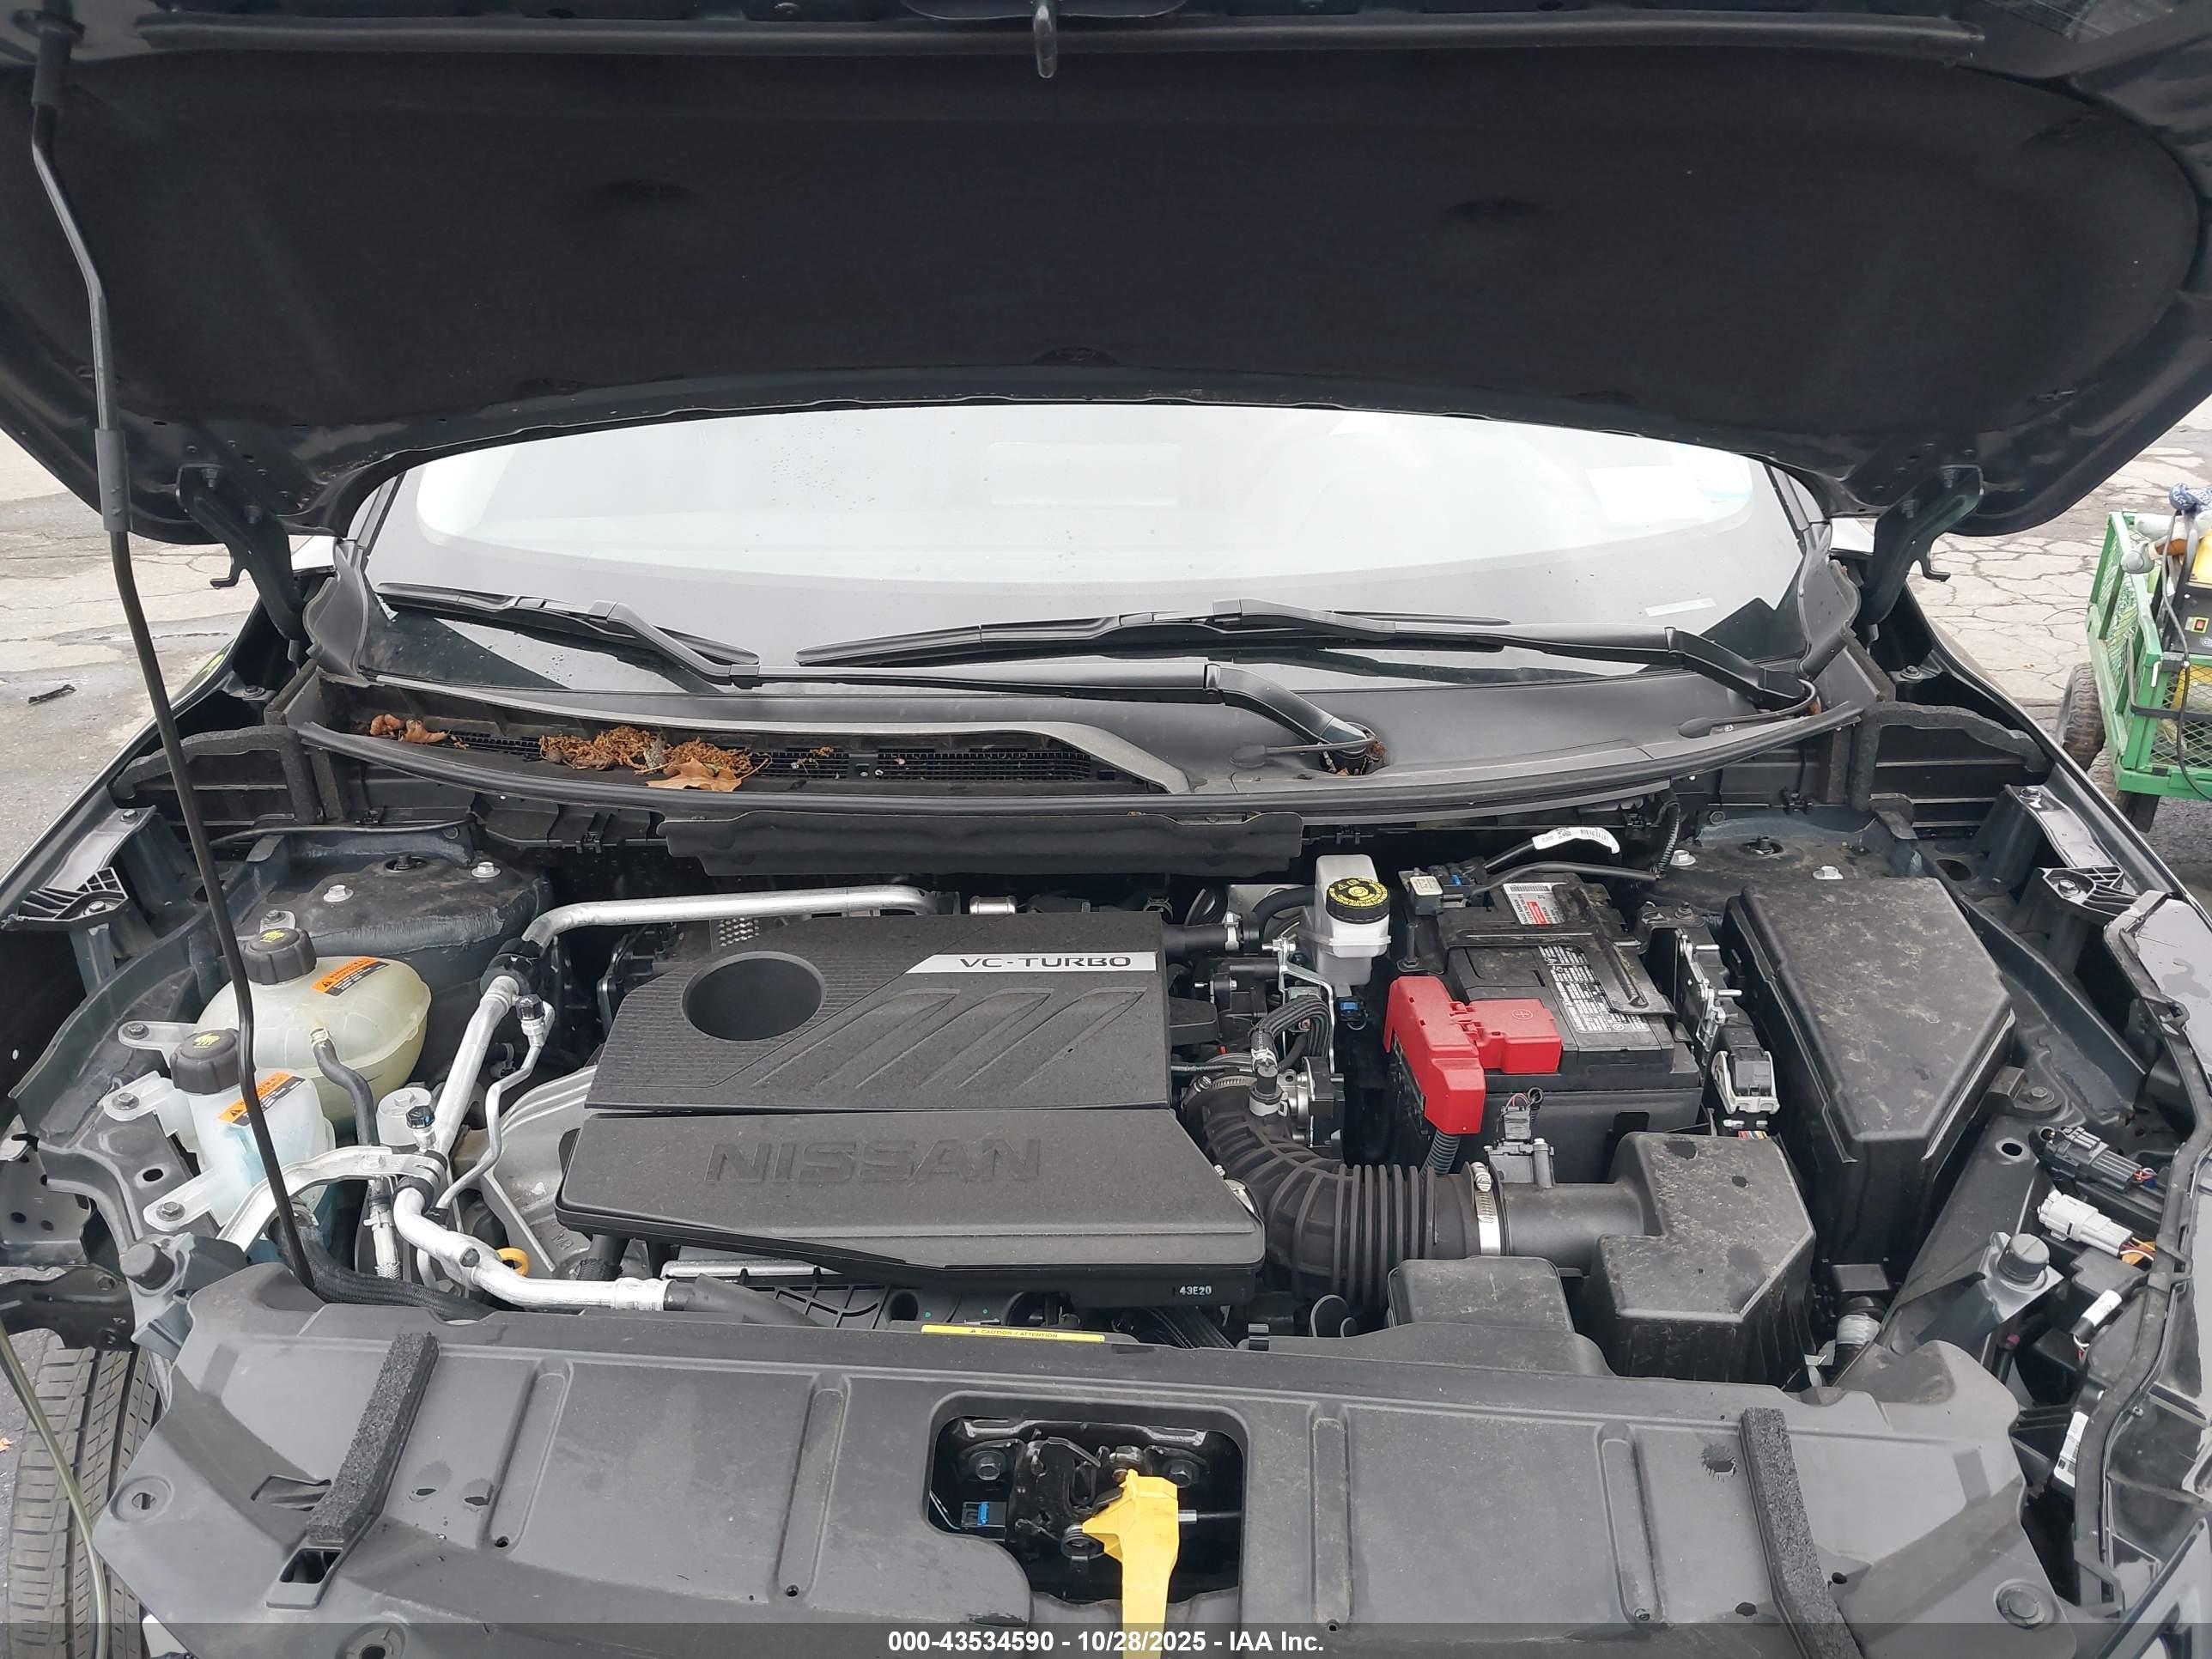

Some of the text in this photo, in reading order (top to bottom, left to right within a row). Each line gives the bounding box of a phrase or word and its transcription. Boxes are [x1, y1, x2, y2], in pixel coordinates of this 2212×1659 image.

[959, 957, 1132, 968] VC-TURBO
[702, 1139, 1040, 1182] NISSAN
[1179, 1285, 1212, 1296] 43E20
